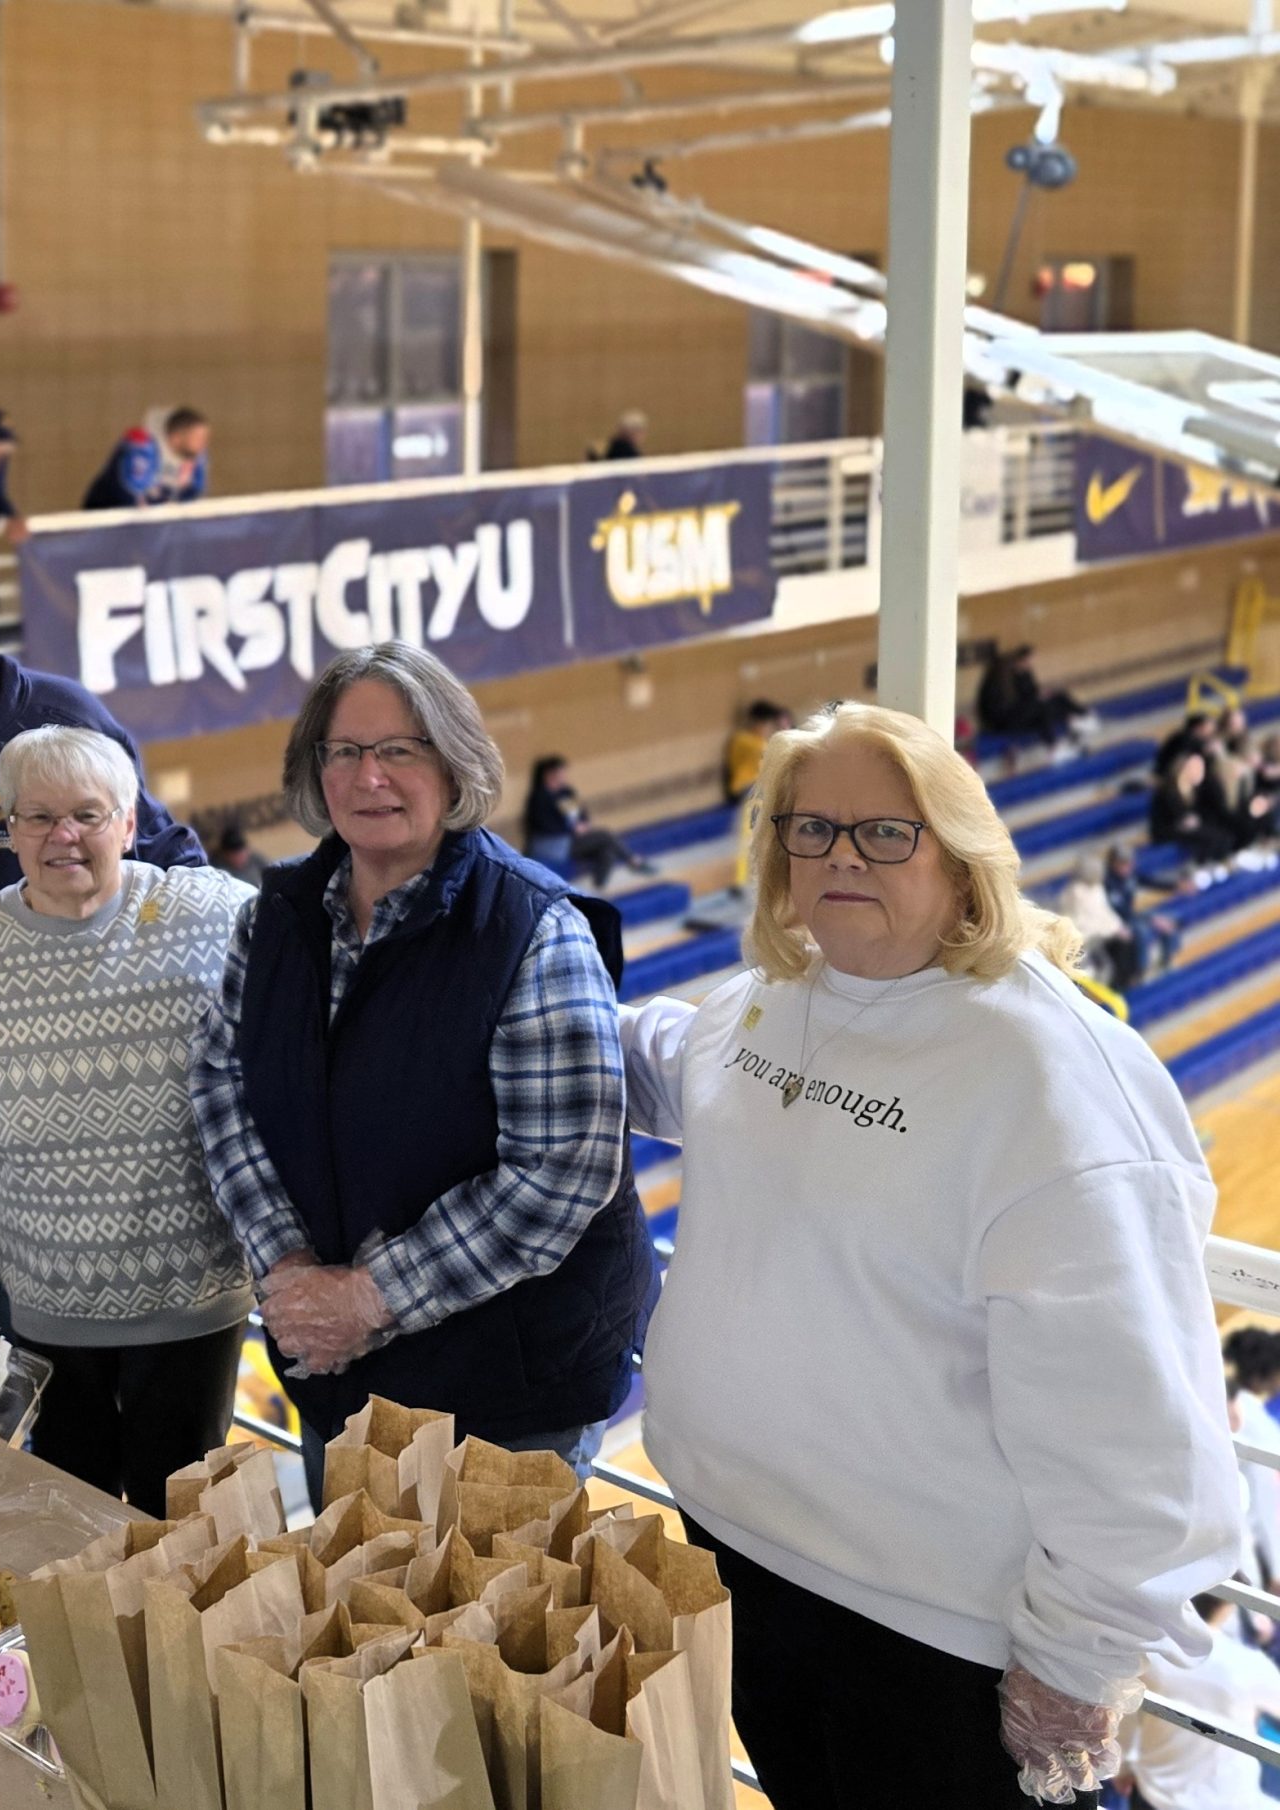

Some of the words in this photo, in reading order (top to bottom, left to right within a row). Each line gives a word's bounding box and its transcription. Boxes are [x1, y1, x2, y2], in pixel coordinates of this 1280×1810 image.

[596, 498, 738, 614] USM
[724, 1047, 772, 1080] you
[768, 1066, 805, 1092] are
[805, 1078, 908, 1134] enough.
